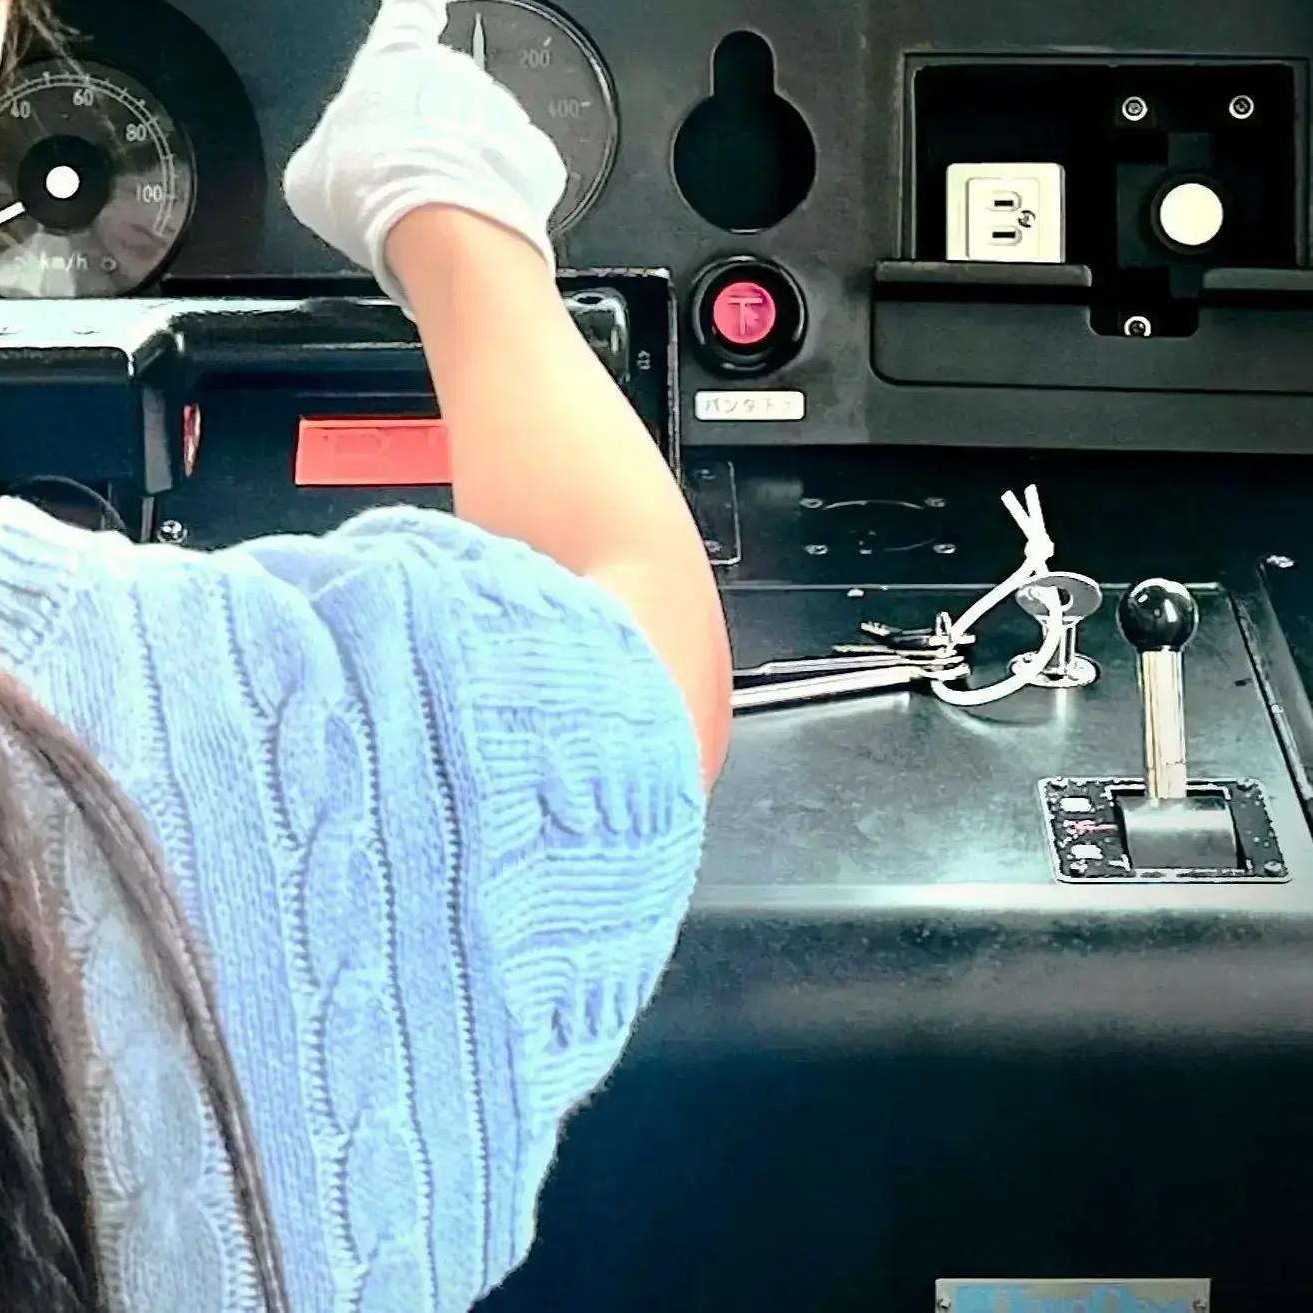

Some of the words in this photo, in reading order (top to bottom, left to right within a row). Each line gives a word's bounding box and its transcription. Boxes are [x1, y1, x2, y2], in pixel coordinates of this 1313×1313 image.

[520, 49, 550, 69] 200
[73, 89, 94, 106] 60
[10, 100, 31, 118] 40
[548, 99, 580, 119] 400
[126, 123, 147, 142] 80
[137, 184, 163, 203] 100
[40, 251, 88, 271] km/h
[727, 297, 763, 336] 下
